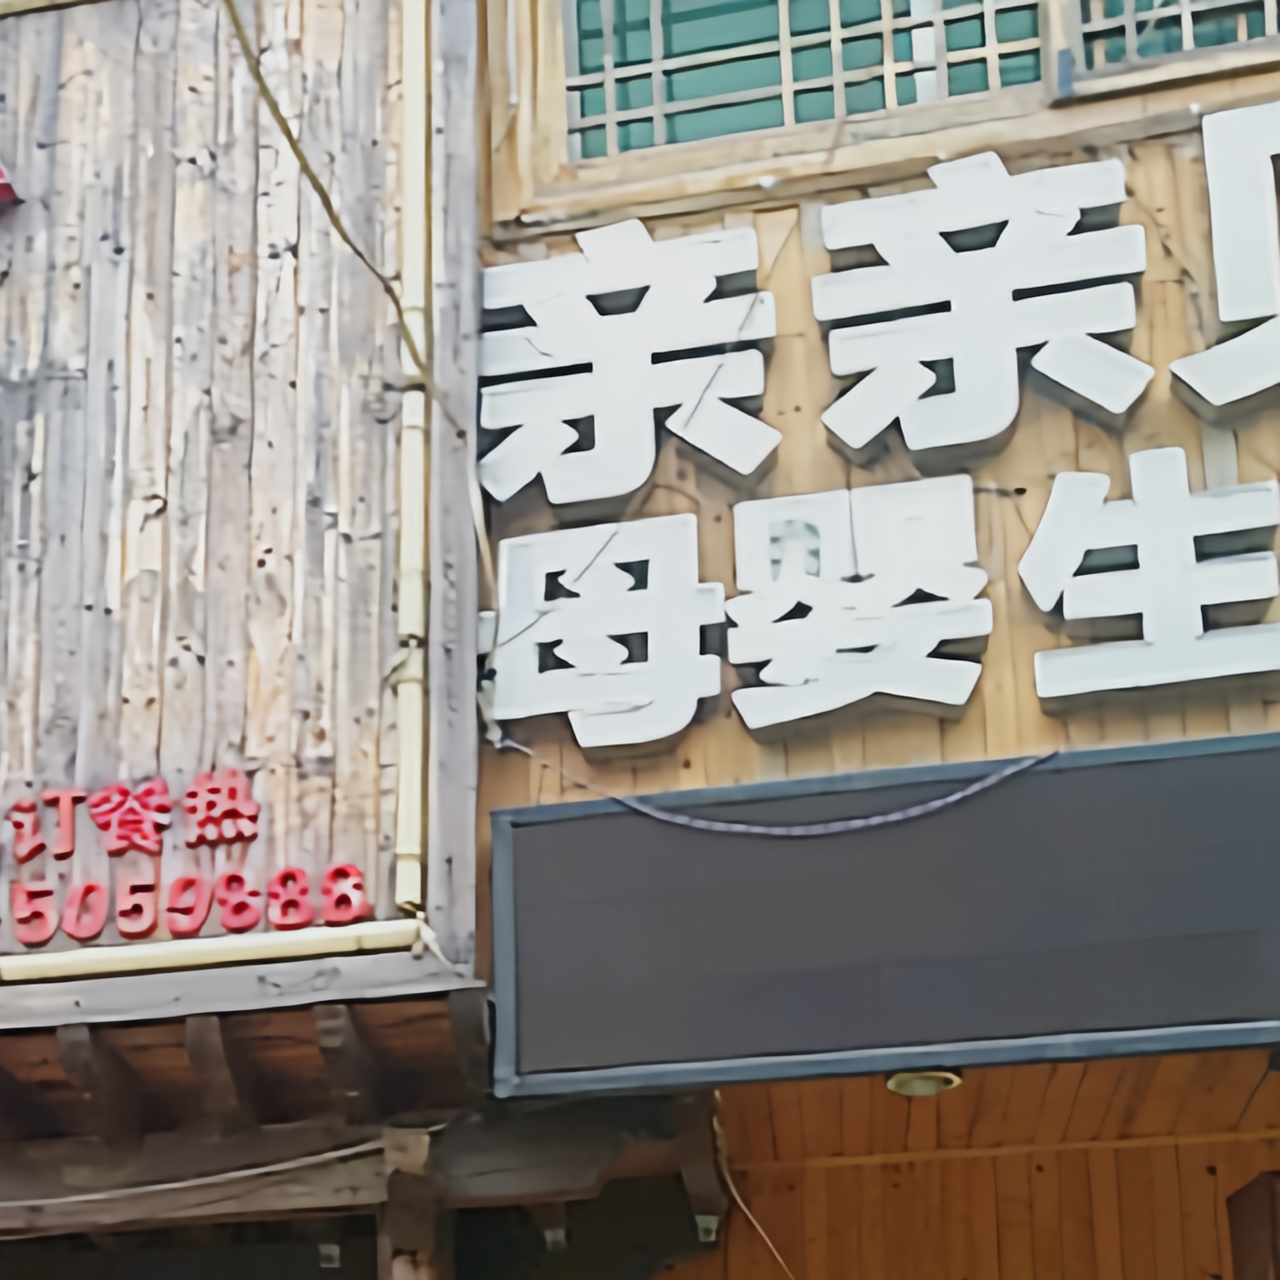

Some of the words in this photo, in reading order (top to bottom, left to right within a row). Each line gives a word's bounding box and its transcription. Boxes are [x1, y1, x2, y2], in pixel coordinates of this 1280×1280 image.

[478, 446, 1280, 748] 母婴生
[8, 769, 261, 863] 订餐热
[9, 865, 373, 947] 5059888
